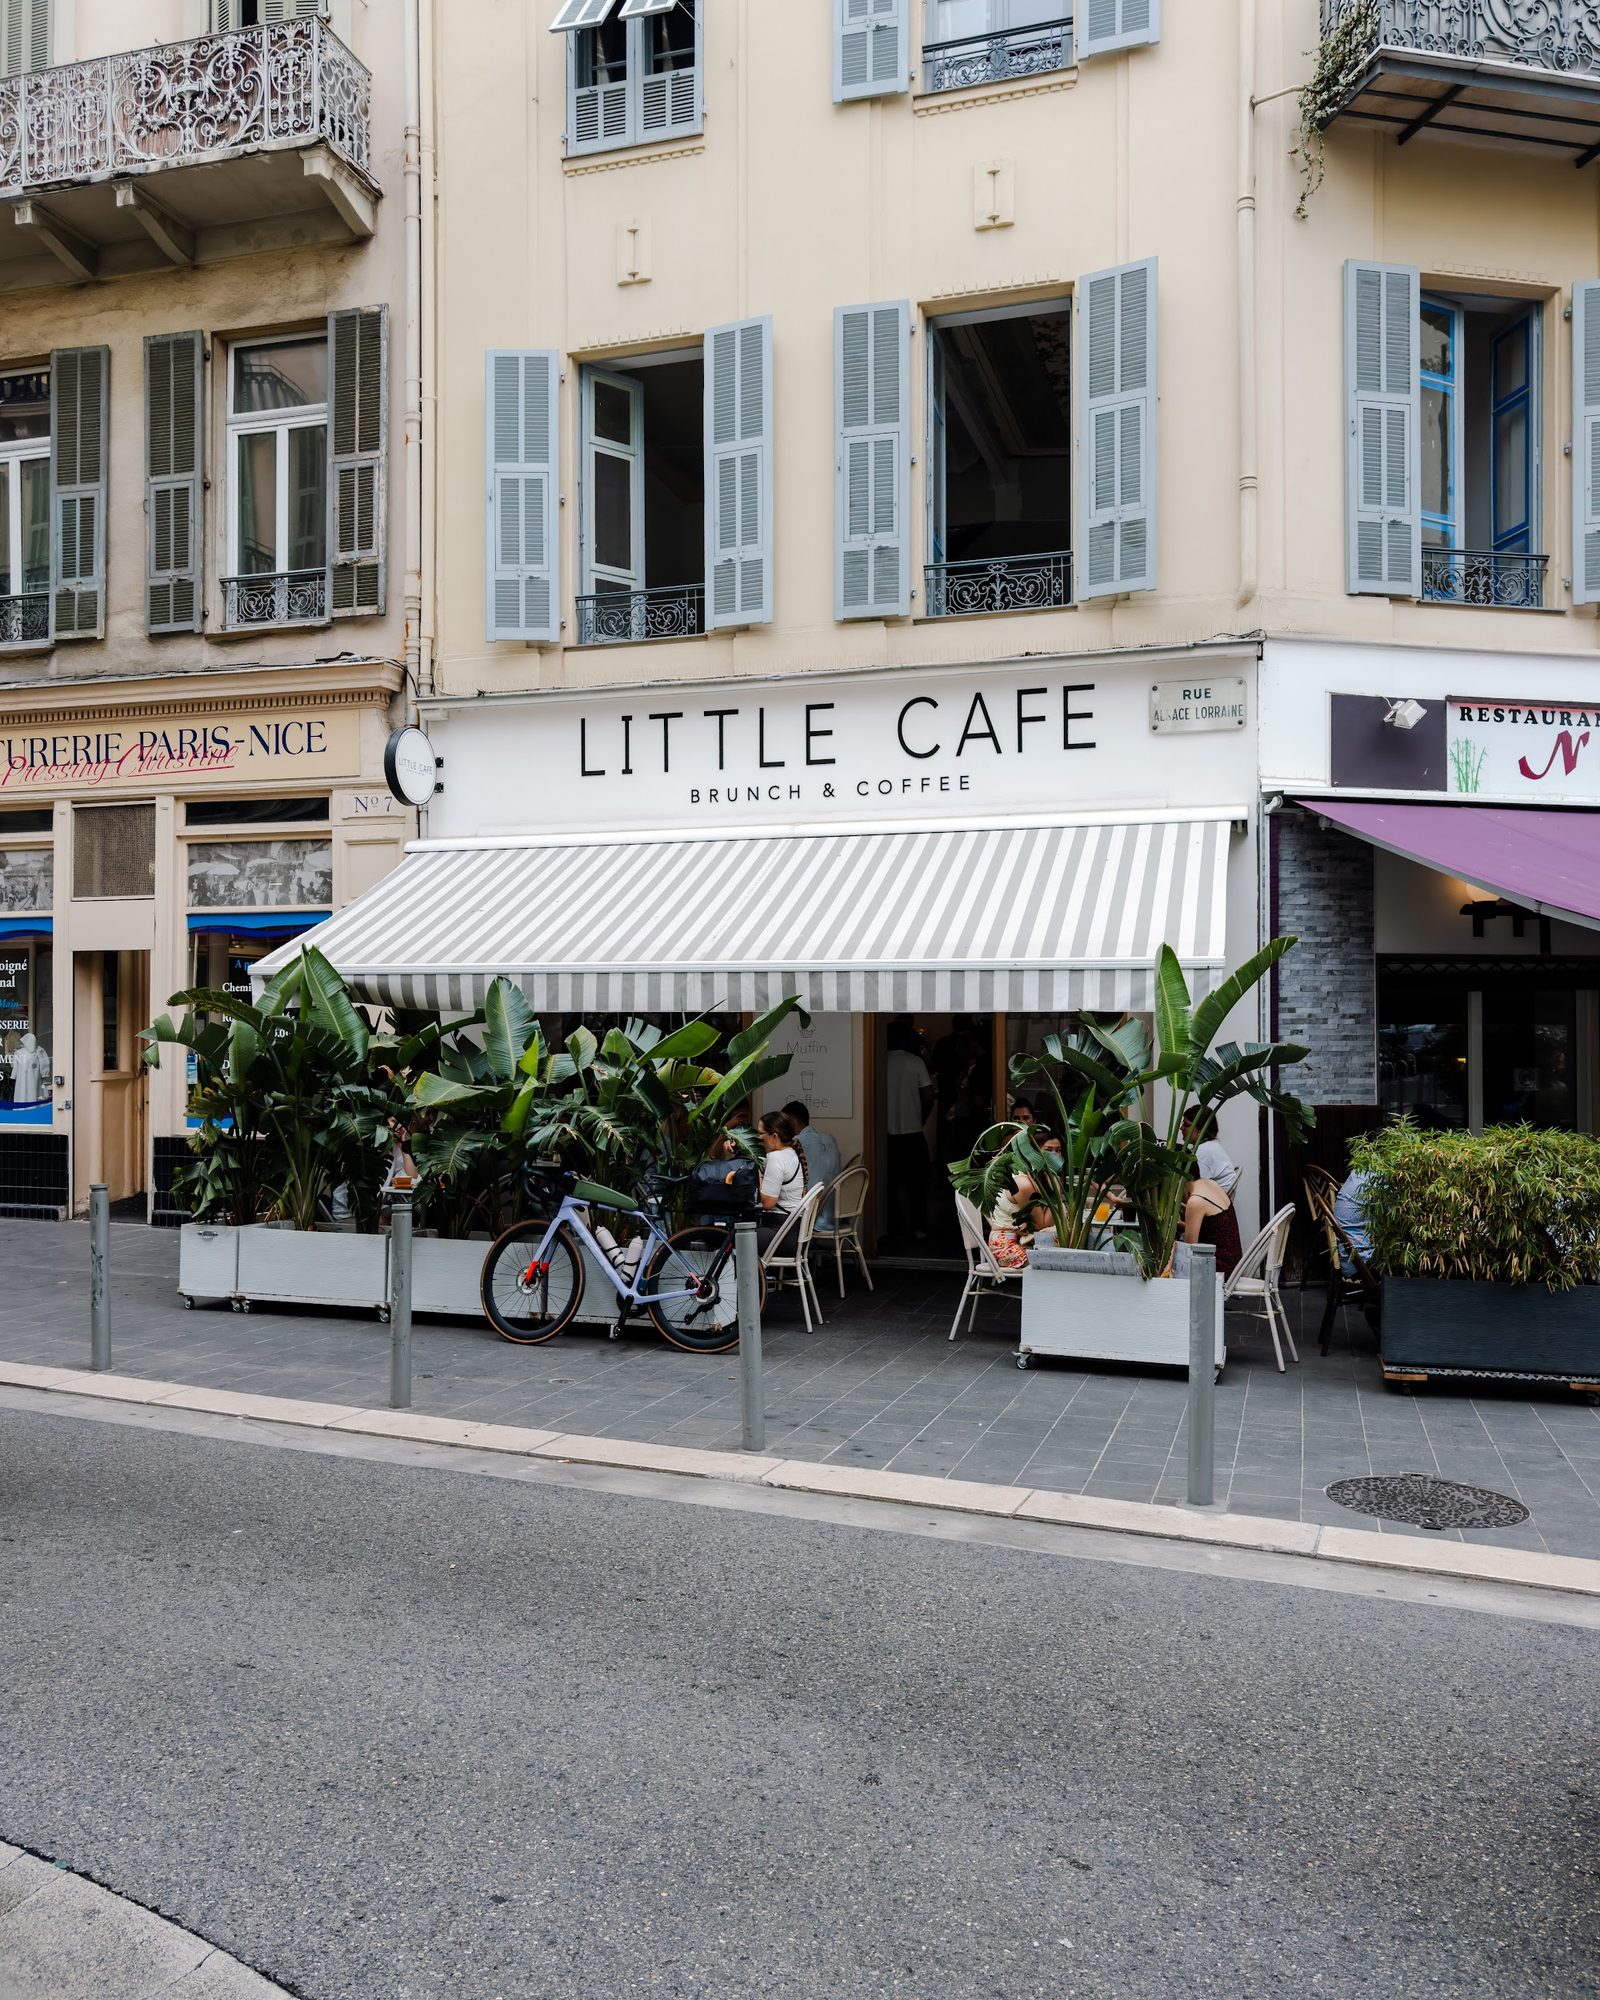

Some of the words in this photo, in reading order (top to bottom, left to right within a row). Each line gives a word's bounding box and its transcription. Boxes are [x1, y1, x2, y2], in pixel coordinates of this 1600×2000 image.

[1183, 688, 1212, 700] RUE
[1195, 704, 1244, 719] LORRAINE
[138, 721, 327, 762] PARIS-NICE
[580, 703, 836, 777] LITTLE
[897, 684, 1097, 759] CAFE
[0, 755, 112, 786] Pressing
[116, 742, 239, 777] Christine
[398, 757, 416, 771] LITTLE
[419, 763, 433, 775] CAFE
[690, 784, 801, 804] BRUNCH
[823, 783, 835, 798] &
[856, 775, 970, 797] COFFEE
[786, 1040, 828, 1054] Muffin
